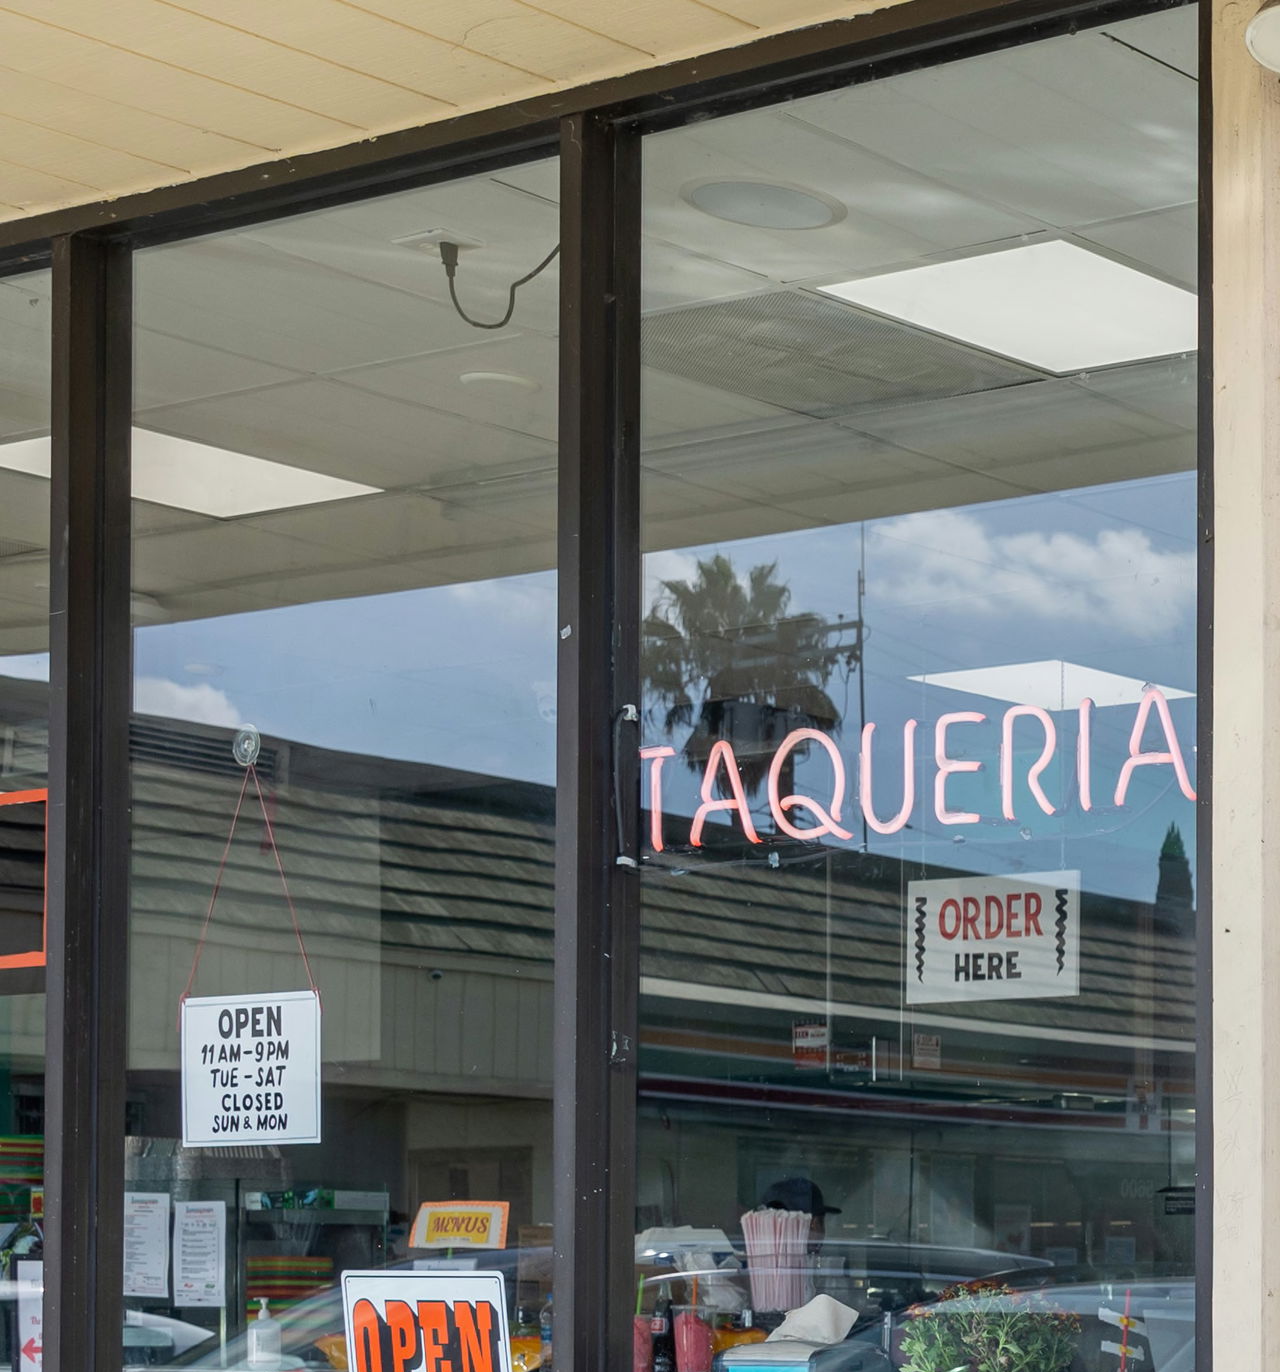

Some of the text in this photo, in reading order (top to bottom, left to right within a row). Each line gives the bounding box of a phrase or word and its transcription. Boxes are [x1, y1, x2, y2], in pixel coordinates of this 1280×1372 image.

[640, 684, 1197, 853] TAQUERIA
[938, 892, 1044, 941] ORDER
[954, 951, 1022, 982] HERE
[218, 1005, 282, 1039] OPEN
[221, 1092, 284, 1113] CLOSED
[212, 1113, 288, 1133] SUN & MON
[432, 1215, 489, 1234] MENUS
